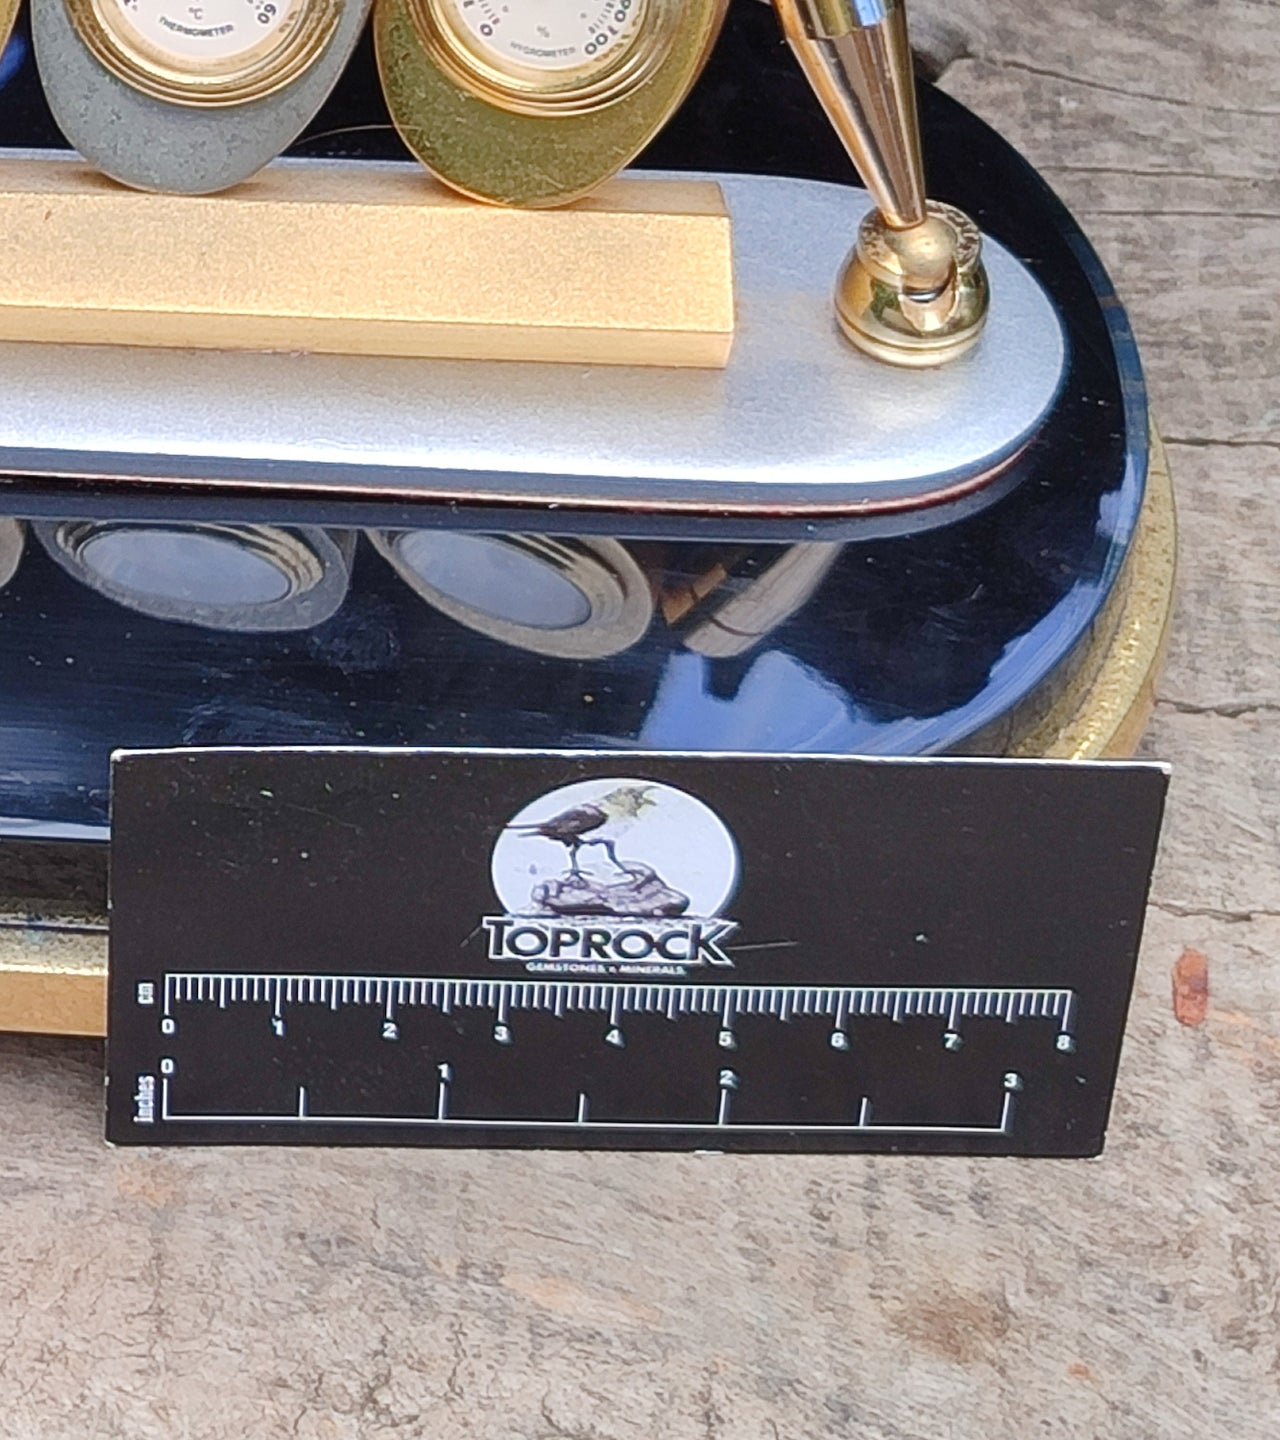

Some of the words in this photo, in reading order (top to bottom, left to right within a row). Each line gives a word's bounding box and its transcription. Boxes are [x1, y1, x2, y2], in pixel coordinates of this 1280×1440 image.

[256, 3, 278, 25] 60
[479, 23, 494, 38] 0
[584, 25, 619, 56] 100
[483, 915, 738, 968] TOPROCK
[525, 961, 605, 974] GEMSTONES
[161, 1018, 175, 1034] 0
[271, 1017, 284, 1037] 1
[382, 1021, 399, 1040] 2
[493, 1024, 511, 1044] 3
[604, 1027, 626, 1047] 4
[718, 1030, 735, 1048] 5
[830, 1031, 847, 1050] 6
[943, 1033, 960, 1052] 7
[1055, 1034, 1073, 1053] 8
[160, 1058, 174, 1074] 0
[719, 1068, 737, 1088] 2
[1002, 1071, 1021, 1092] 3
